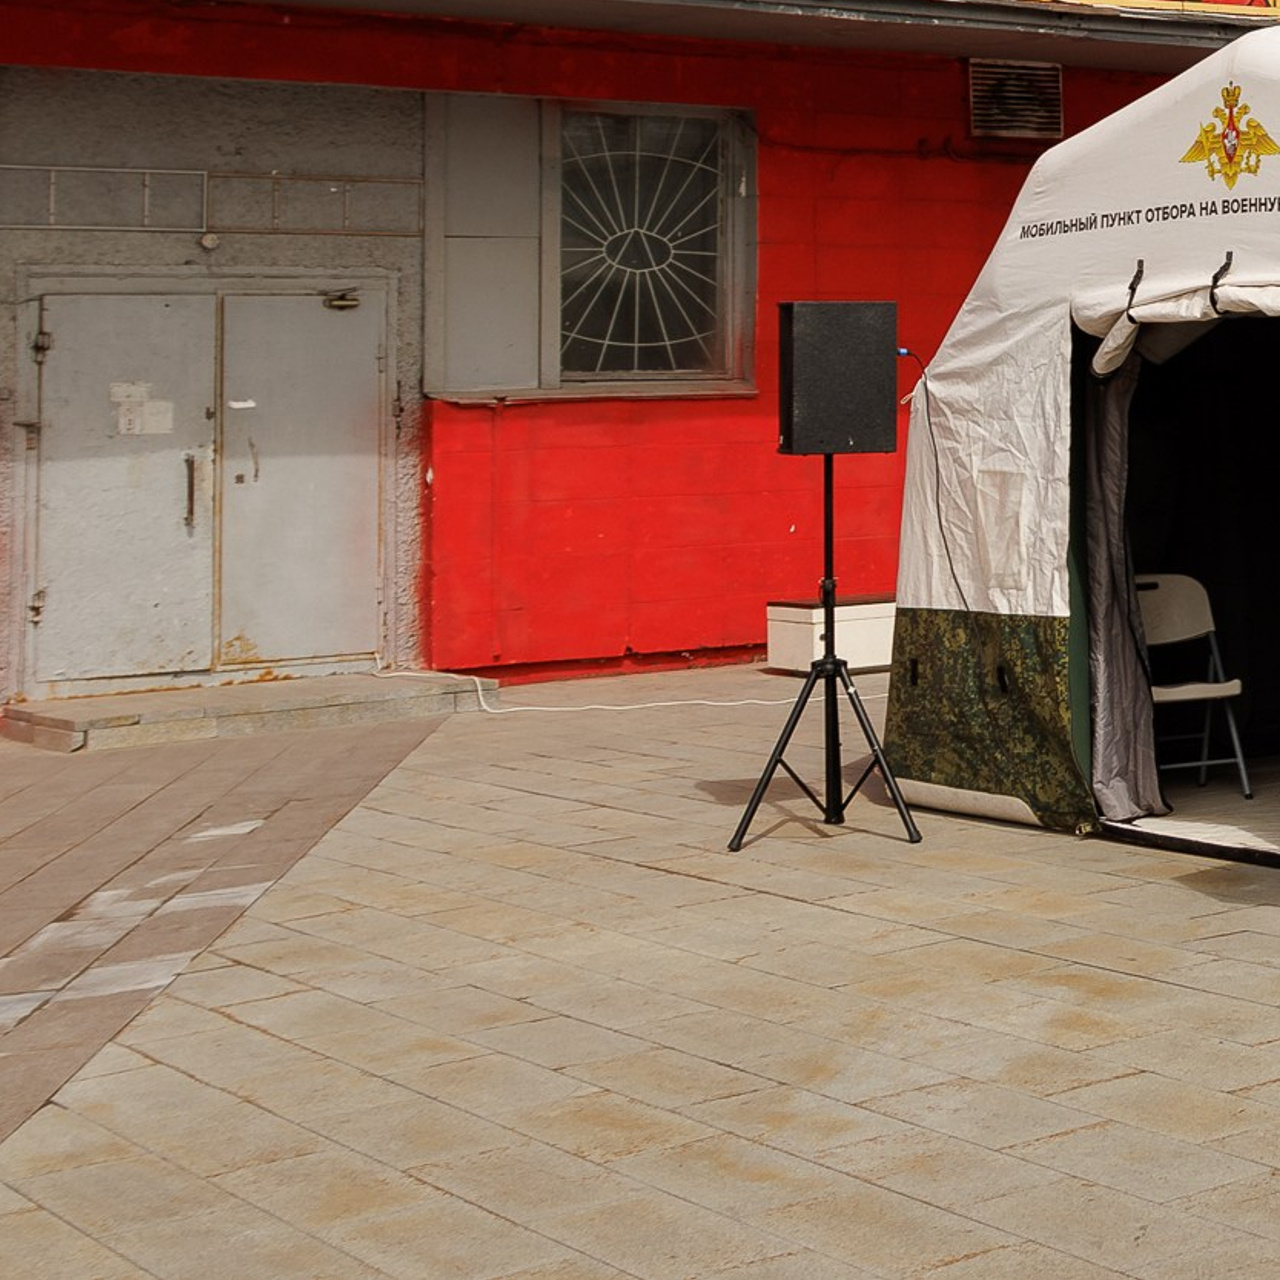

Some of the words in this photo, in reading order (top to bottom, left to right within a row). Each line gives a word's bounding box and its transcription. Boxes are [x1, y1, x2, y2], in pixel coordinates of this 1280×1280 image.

[1020, 212, 1098, 240] МОБИЛЬНЫЙ
[1100, 209, 1142, 230] ПУНКТ
[1145, 204, 1197, 224] ОТБОРА
[1199, 201, 1219, 217] НА
